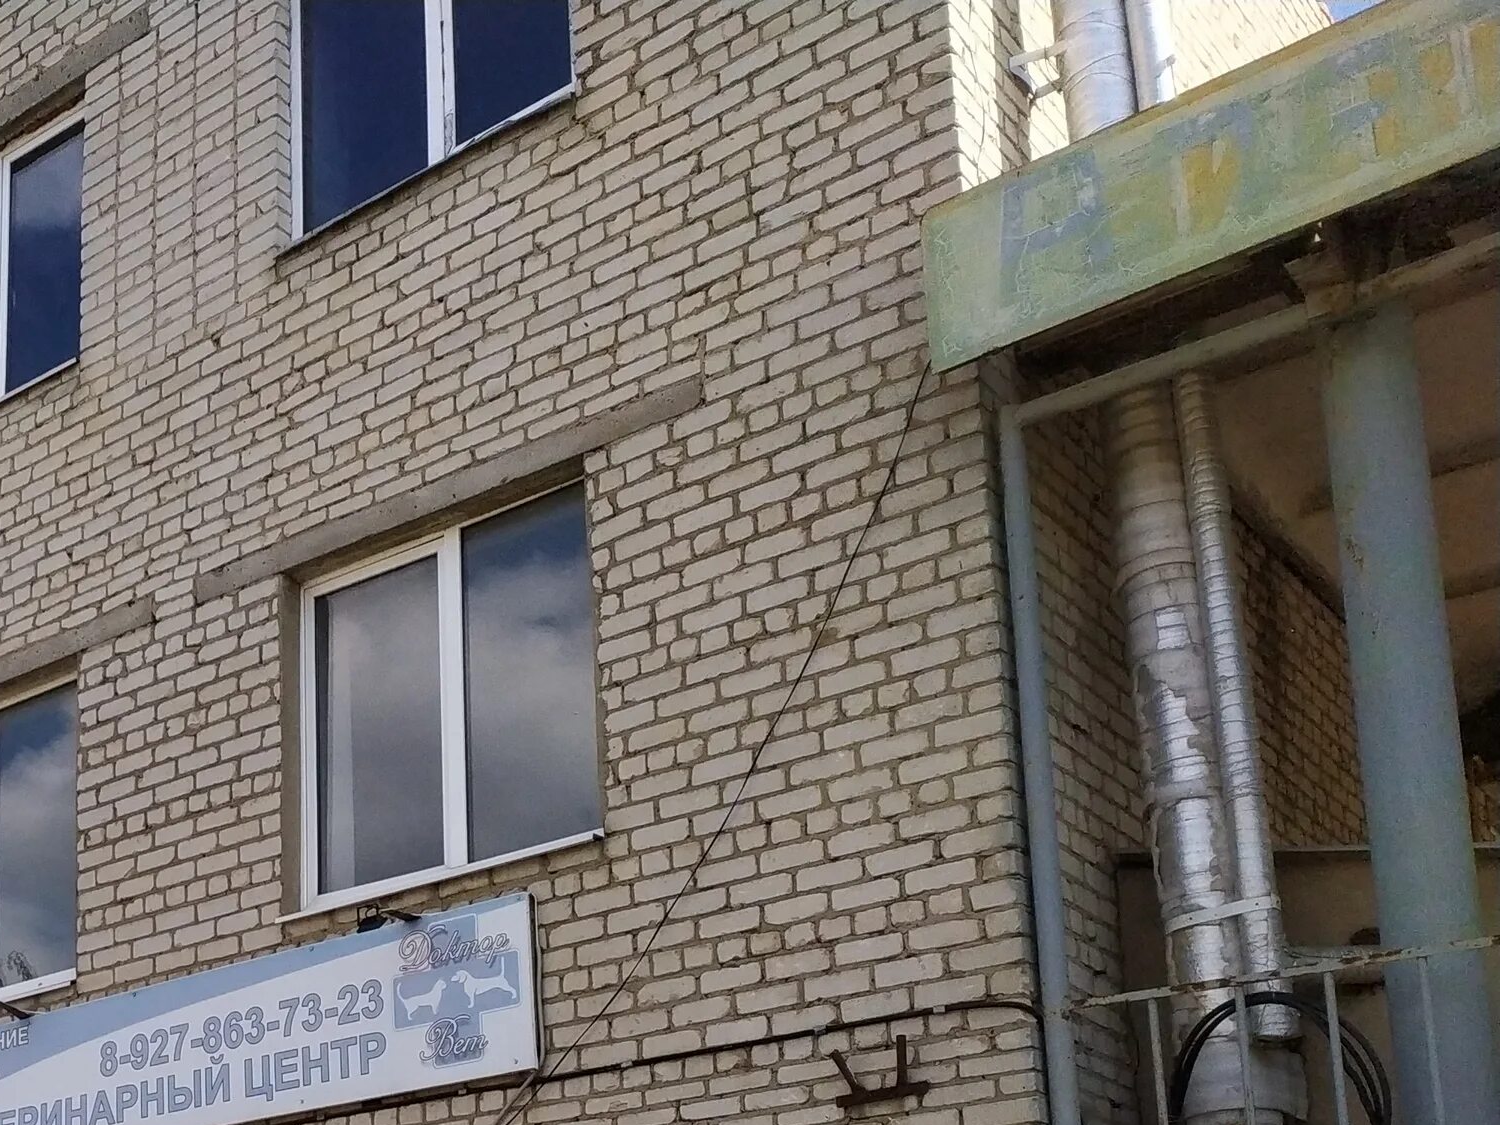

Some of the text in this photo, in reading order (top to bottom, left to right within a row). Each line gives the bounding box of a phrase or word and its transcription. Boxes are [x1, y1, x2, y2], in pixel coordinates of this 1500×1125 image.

[399, 924, 509, 972] Доктор
[100, 979, 384, 1077] 8-927-863-73-23
[419, 1014, 489, 1062] Вет
[243, 1032, 387, 1102] ЦЕНТР
